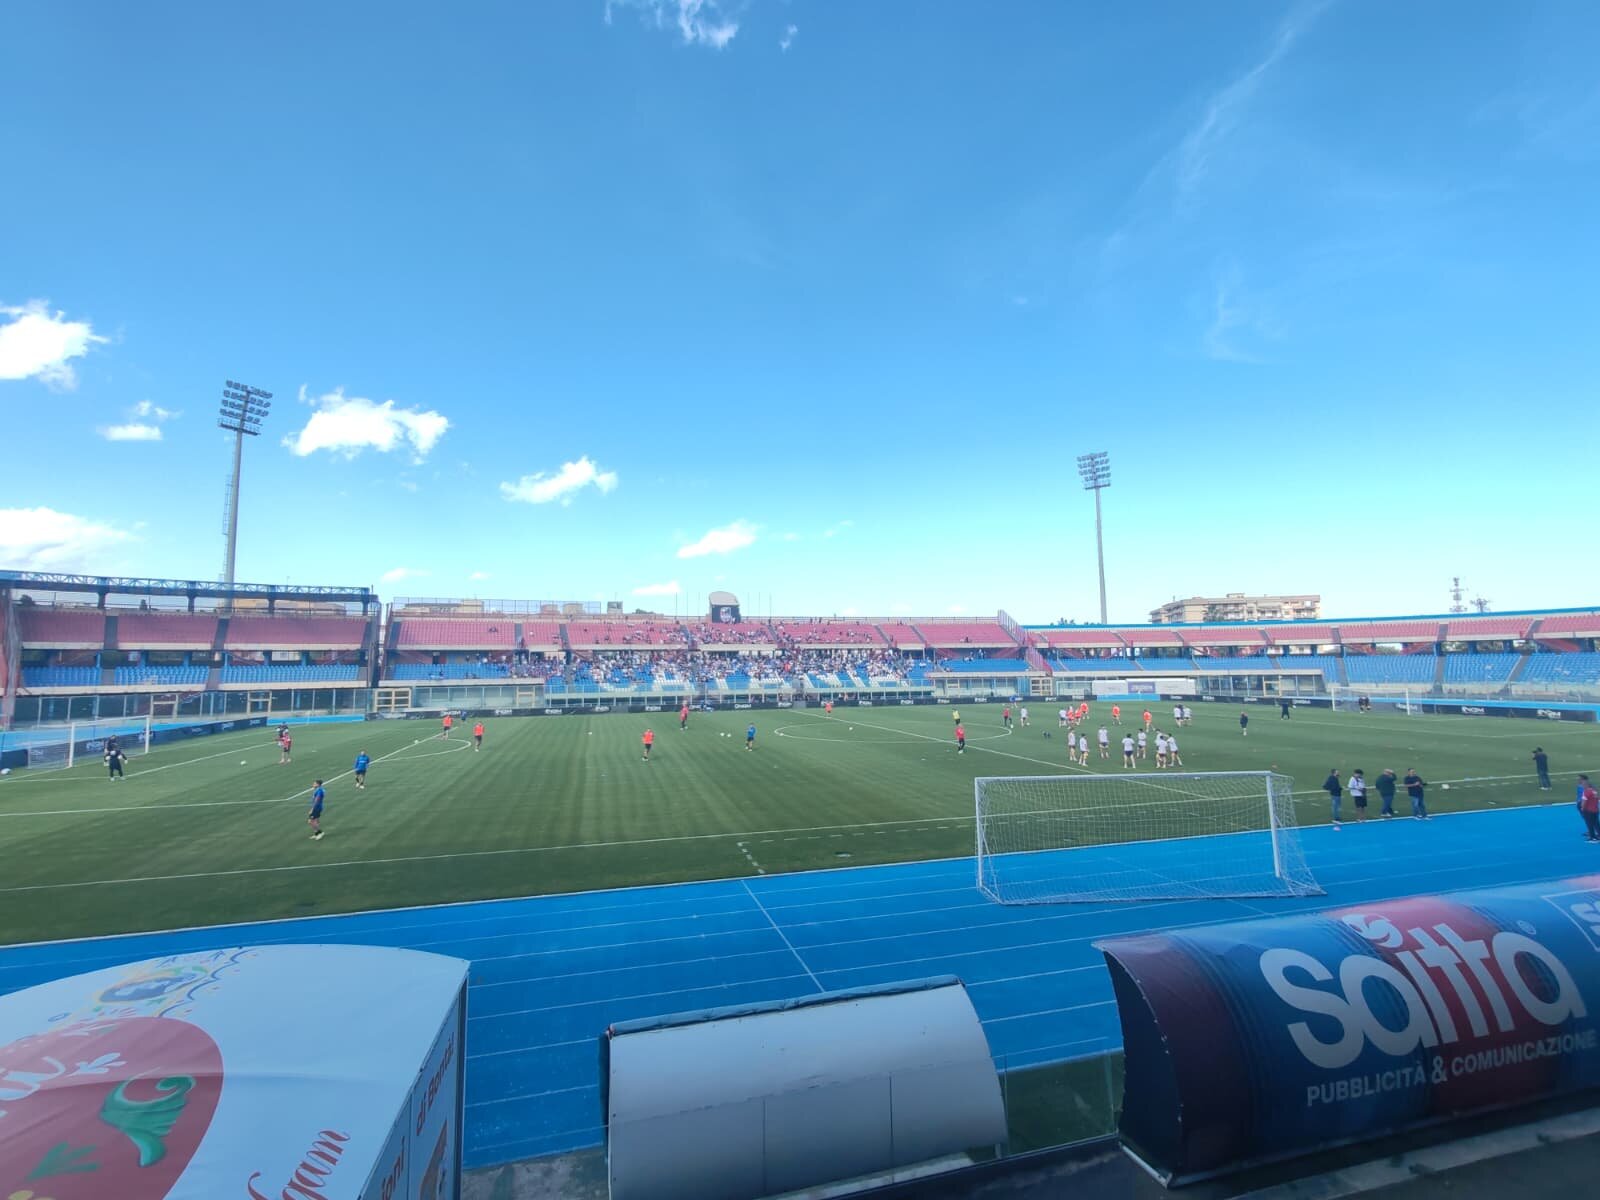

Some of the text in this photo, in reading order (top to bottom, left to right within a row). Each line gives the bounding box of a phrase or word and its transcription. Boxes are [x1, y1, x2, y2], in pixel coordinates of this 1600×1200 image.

[1259, 913, 1587, 1069] saitta
[1306, 1029, 1597, 1107] PUBBLICITÀ & COMUNICAZIONE
